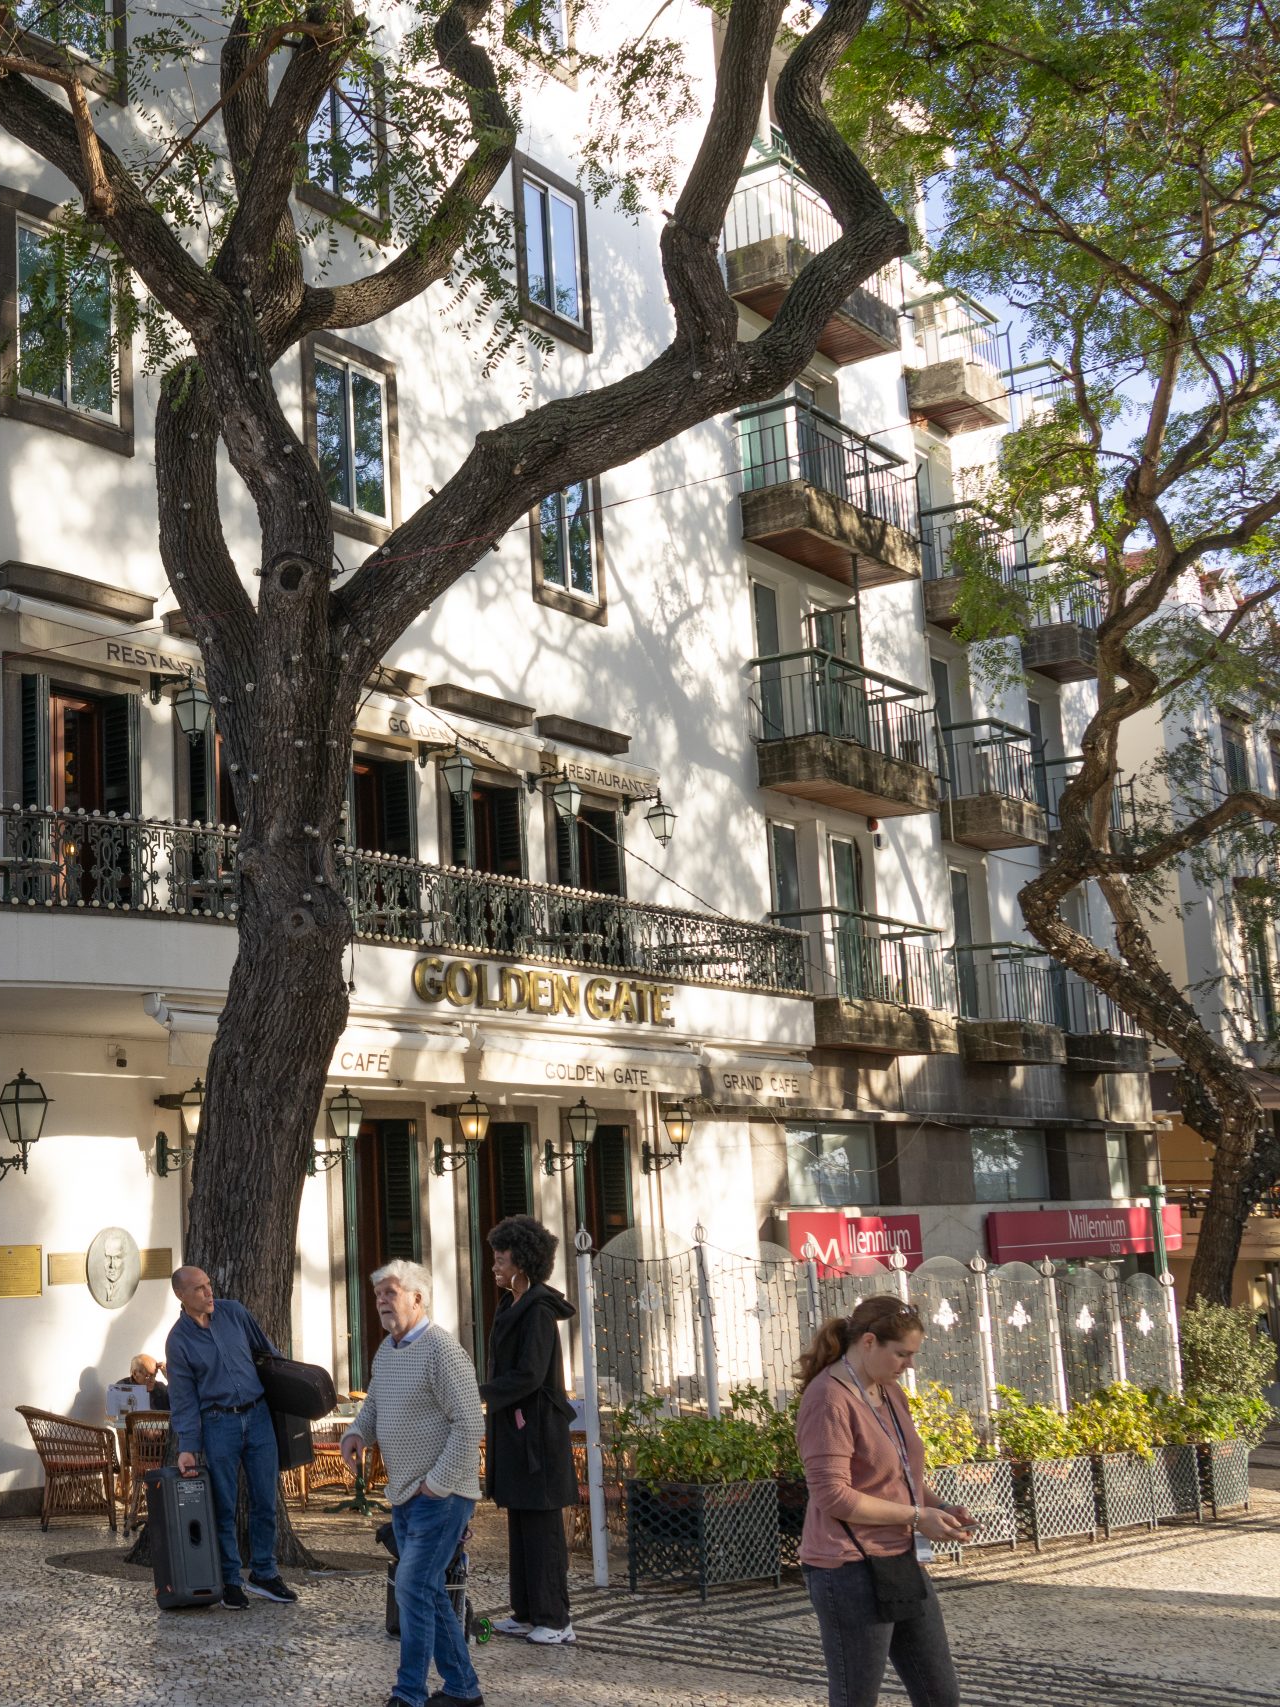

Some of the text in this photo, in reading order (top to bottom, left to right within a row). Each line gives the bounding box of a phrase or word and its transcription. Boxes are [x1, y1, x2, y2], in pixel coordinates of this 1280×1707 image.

[106, 642, 205, 679] RESTAURA
[388, 717, 453, 744] GOLDEN
[568, 763, 655, 795] RESTAURANTE
[412, 956, 676, 1028] GOLDEN GATE
[340, 1049, 389, 1073] CAFÉ
[544, 1061, 651, 1086] GOLDEN GATE
[723, 1073, 799, 1095] GRAND CAFÉ
[848, 1223, 912, 1254] llennium
[1068, 1210, 1127, 1240] Millennium
